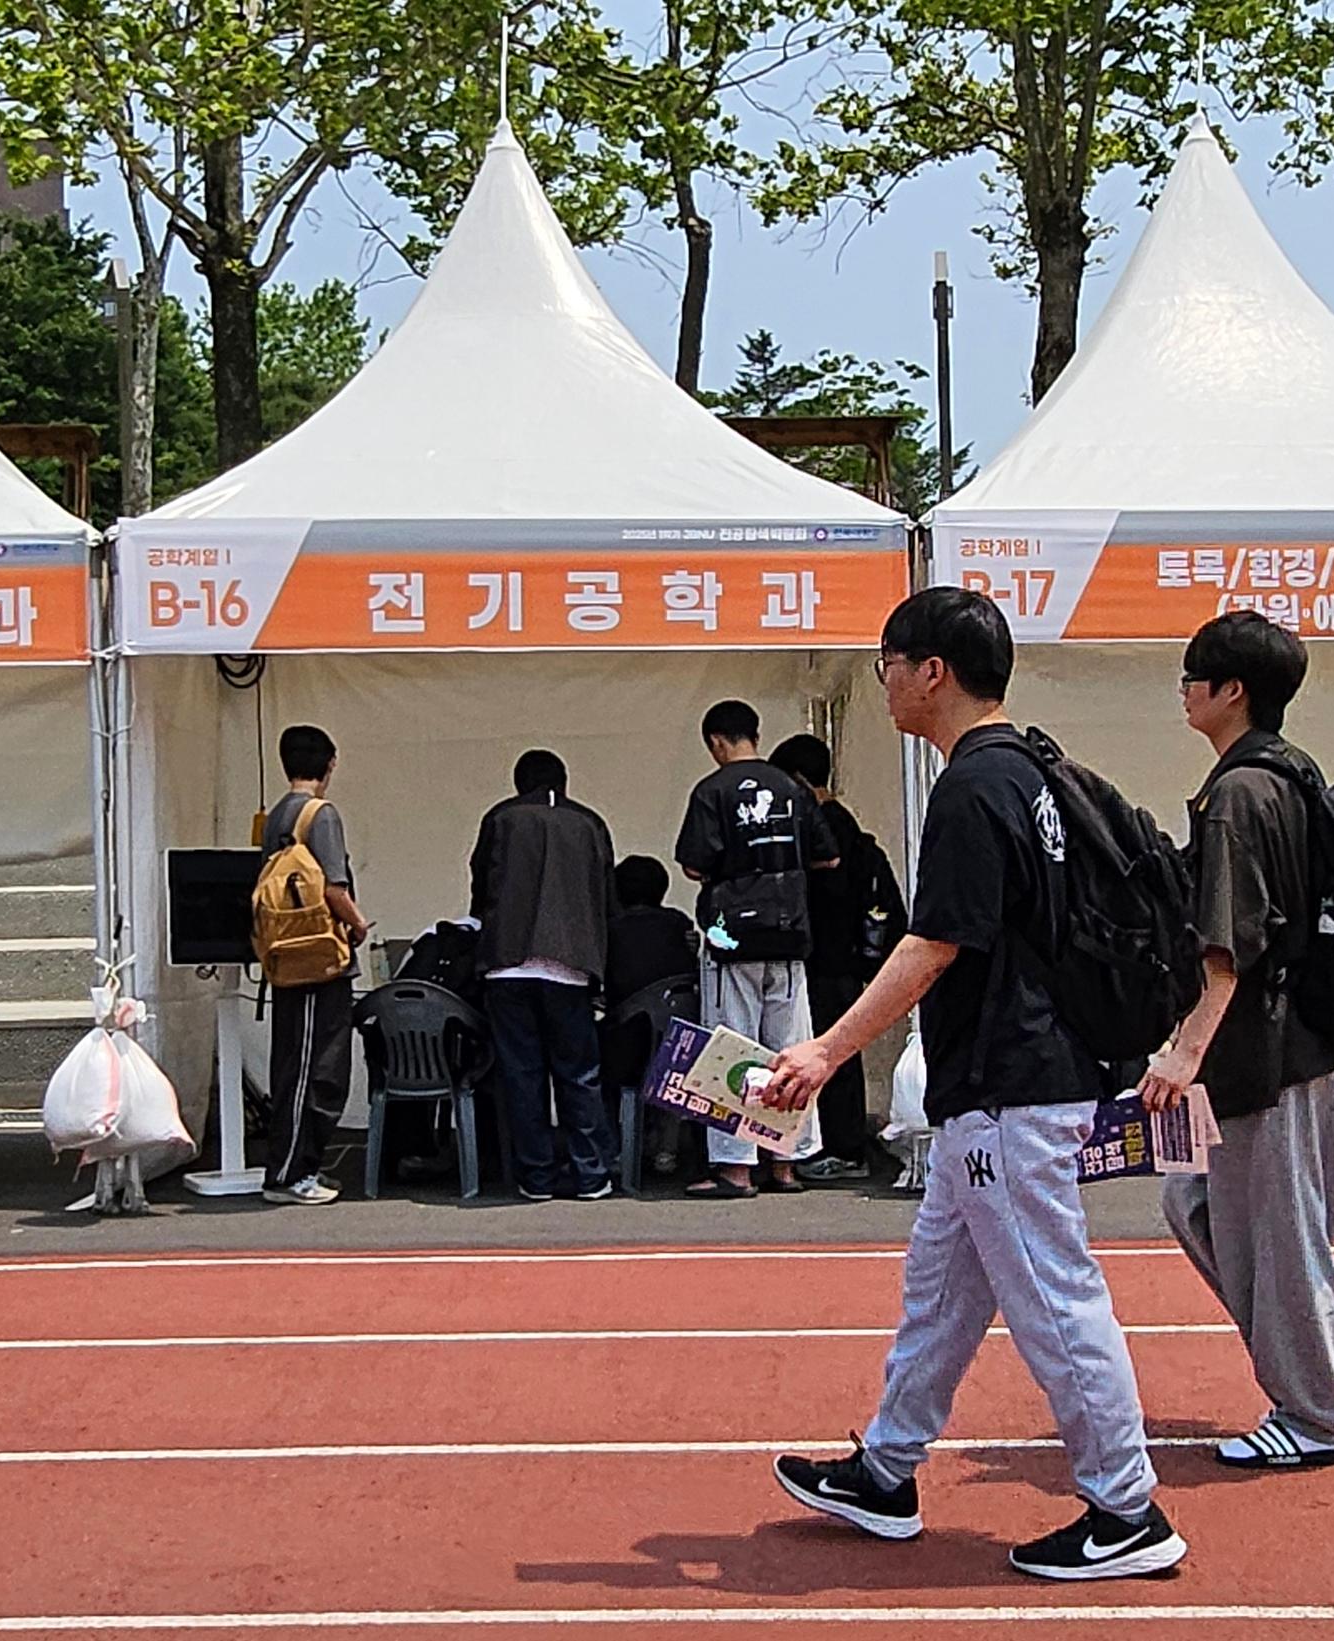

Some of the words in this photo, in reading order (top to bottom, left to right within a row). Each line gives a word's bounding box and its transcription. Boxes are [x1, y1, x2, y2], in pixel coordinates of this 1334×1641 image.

[960, 538, 1029, 557] 공학계열
[147, 548, 218, 567] 공학계열
[149, 579, 249, 627] B-16
